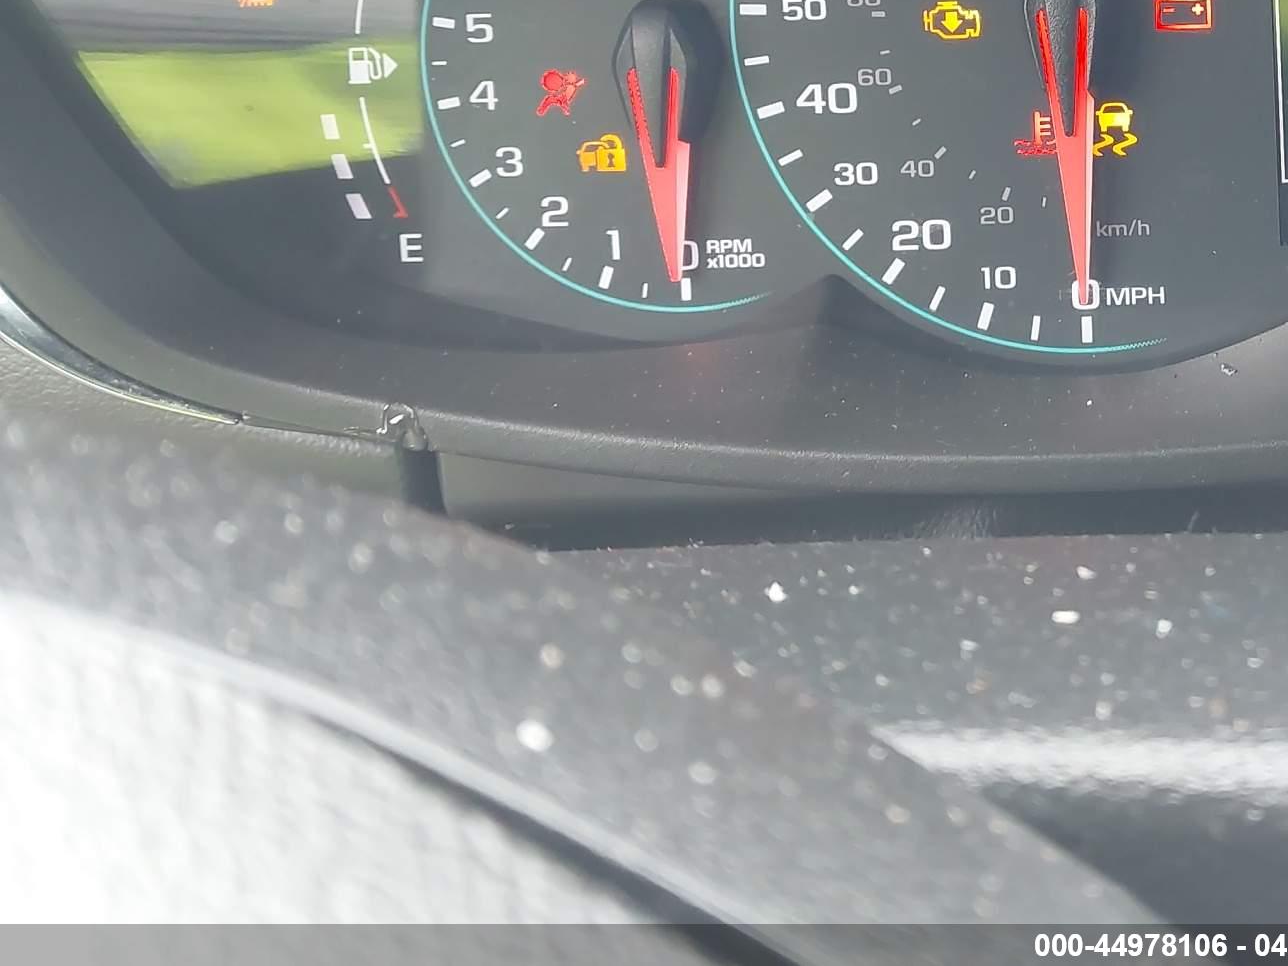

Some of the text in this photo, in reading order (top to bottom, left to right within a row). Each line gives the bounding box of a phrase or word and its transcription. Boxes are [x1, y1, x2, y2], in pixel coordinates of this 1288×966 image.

[466, 13, 494, 44] 5
[857, 68, 892, 86] 60
[469, 80, 498, 110] 4
[796, 83, 858, 114] 40
[496, 147, 524, 176] 3
[834, 162, 878, 186] 30
[900, 160, 935, 178] 40
[540, 196, 569, 227] 2
[980, 206, 1014, 225] 20
[891, 219, 952, 251] 20
[1096, 220, 1150, 237] km/h
[400, 234, 424, 262] E
[606, 230, 621, 260] 1
[706, 238, 752, 254] RPM
[706, 253, 766, 269] x1000
[980, 266, 1016, 290] 10
[1071, 280, 1100, 310] 0
[1106, 287, 1165, 306] MPH
